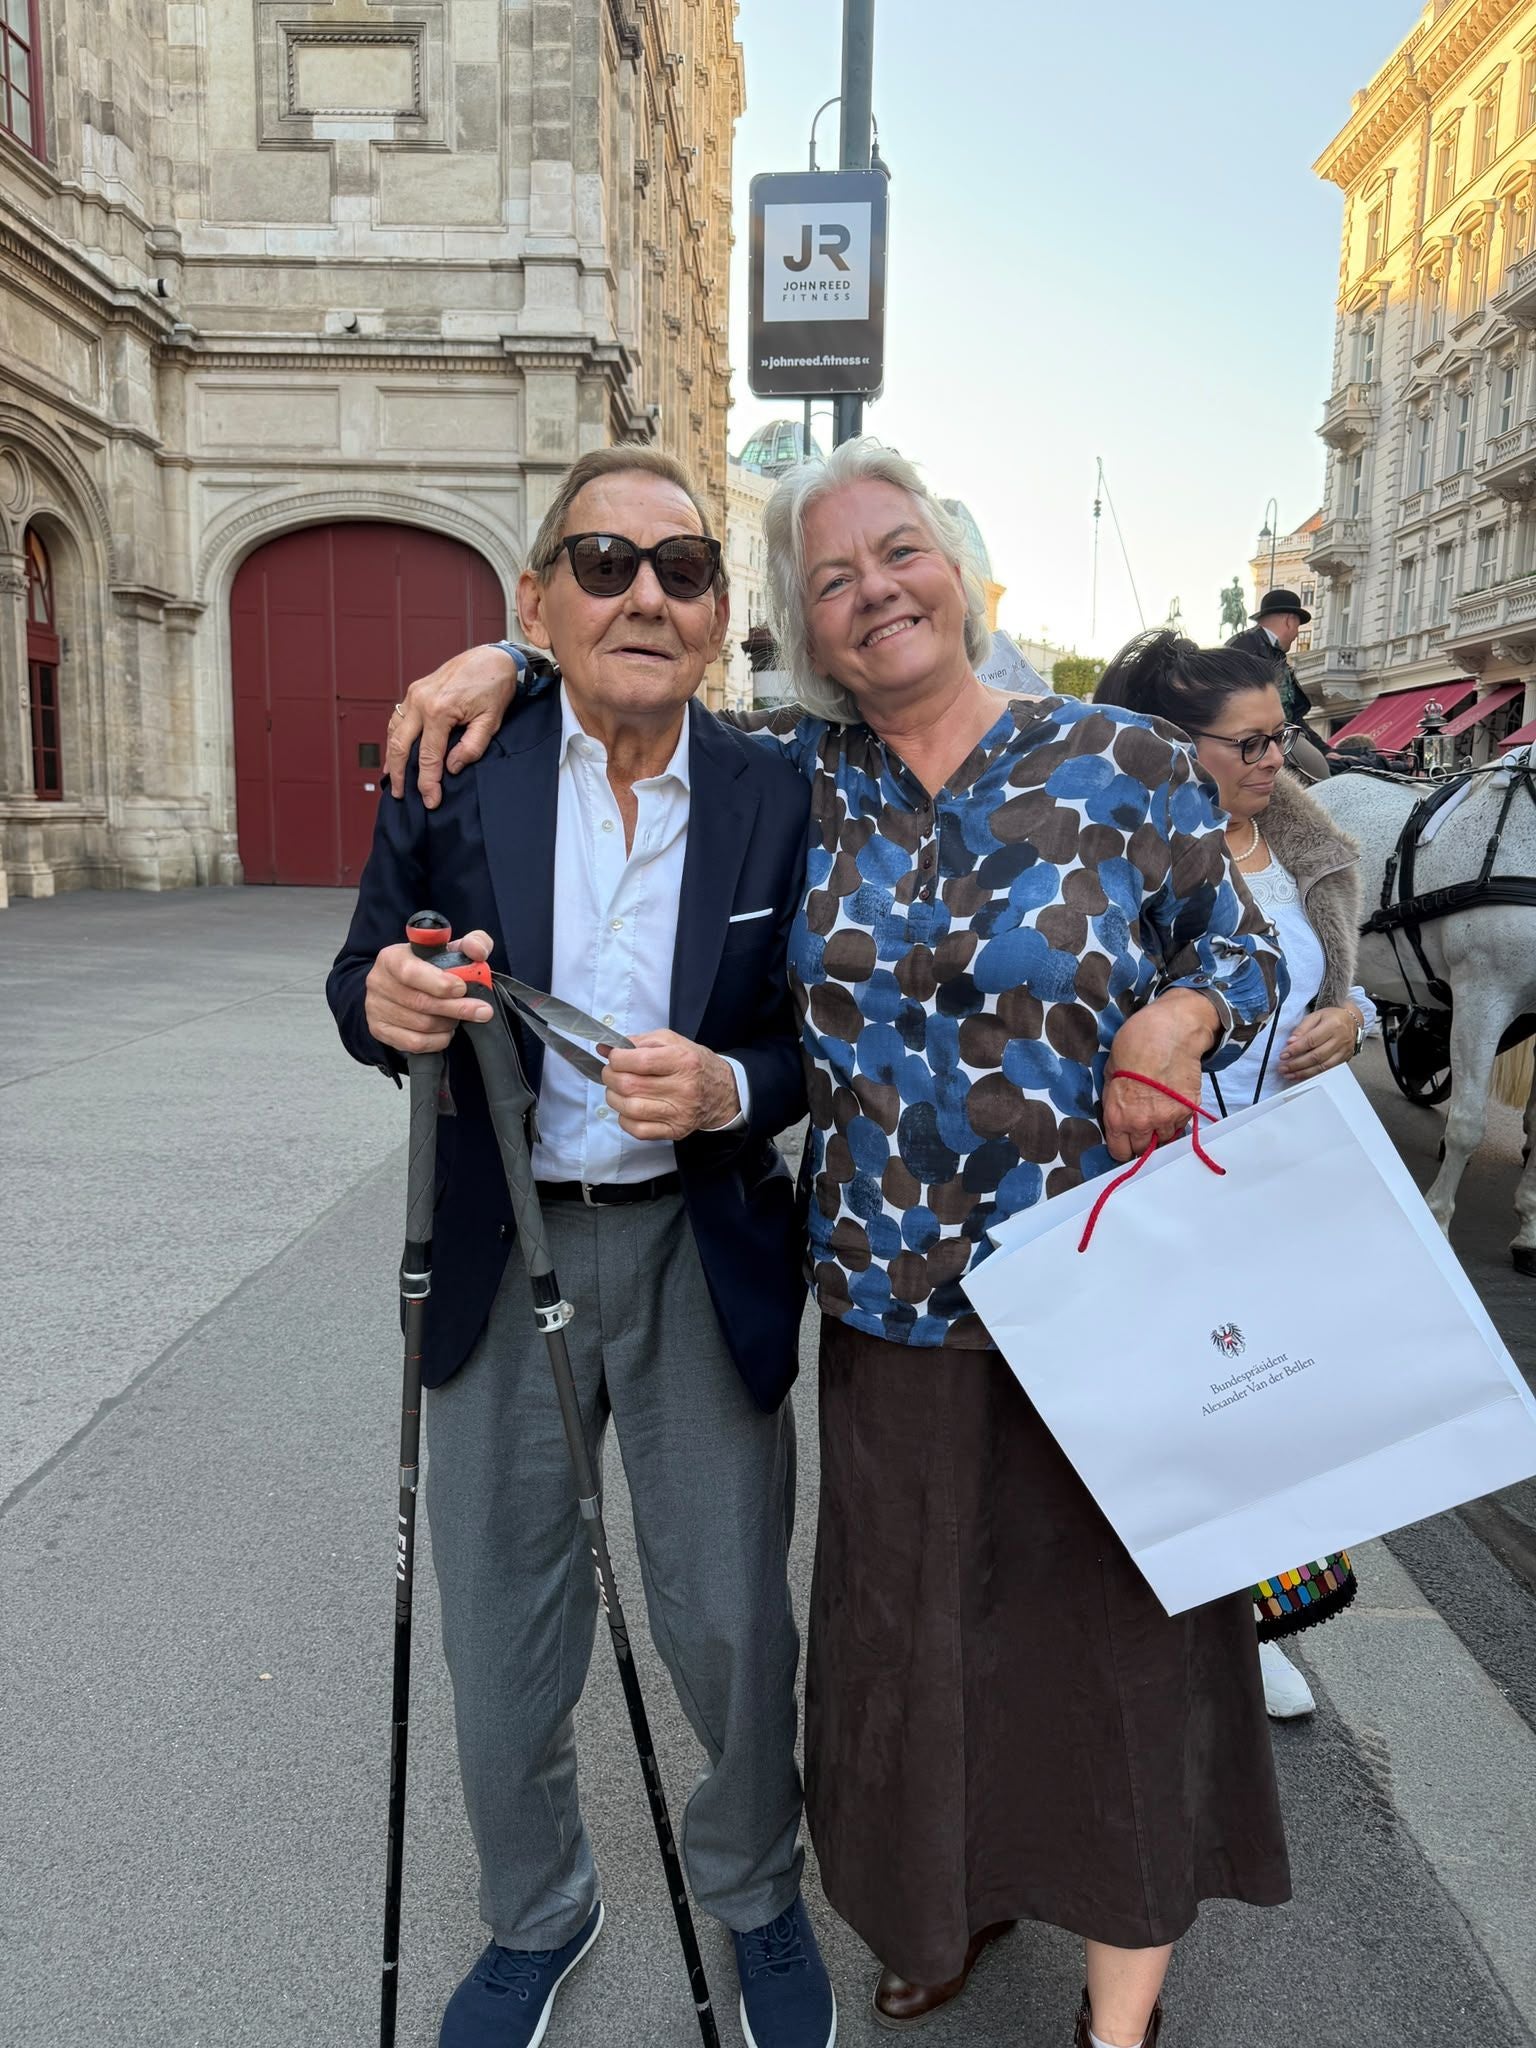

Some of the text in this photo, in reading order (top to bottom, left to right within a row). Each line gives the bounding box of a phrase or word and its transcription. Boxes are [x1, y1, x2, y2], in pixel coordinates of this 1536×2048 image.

[783, 224, 851, 272] JR
[782, 293, 850, 302] FITNESS
[783, 280, 851, 291] JOHN REED
[987, 668, 1007, 681] wien
[1201, 1357, 1315, 1416] Alexander Van der Bellen
[1210, 1353, 1288, 1394] Bundespräsident
